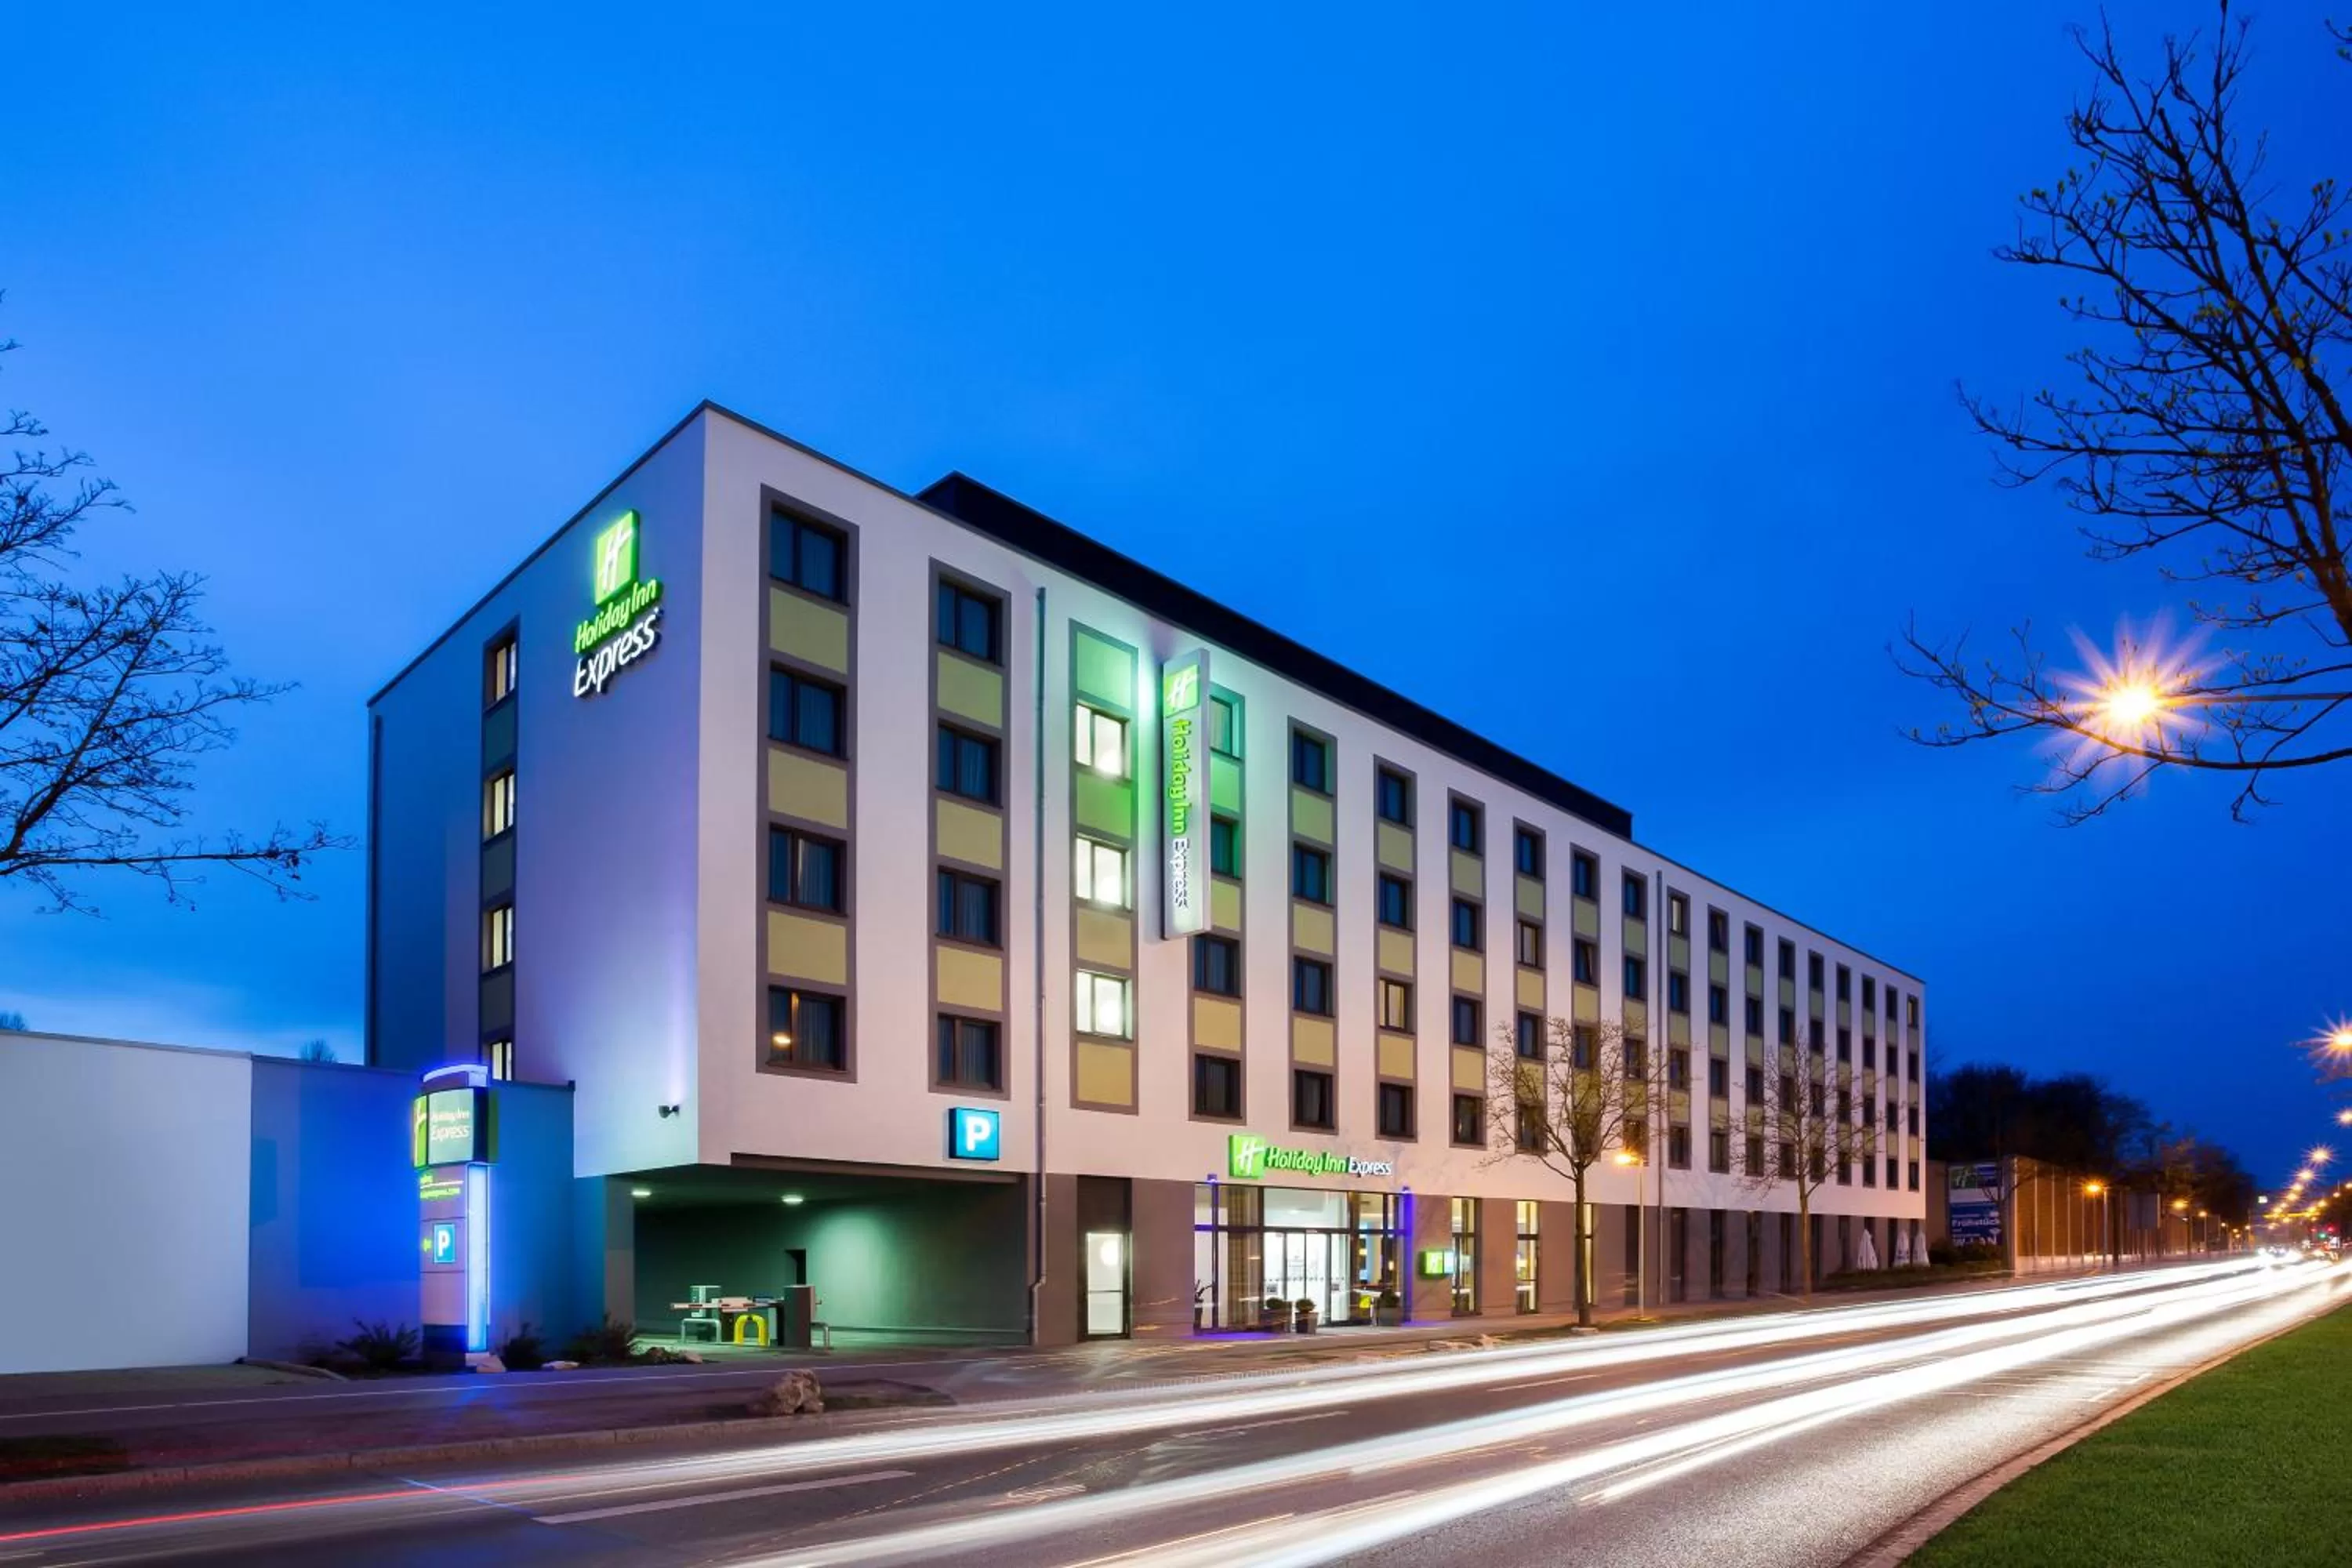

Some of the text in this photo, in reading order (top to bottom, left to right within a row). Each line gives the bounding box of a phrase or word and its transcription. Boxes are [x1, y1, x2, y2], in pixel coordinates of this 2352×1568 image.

[575, 579, 657, 654] Holiday Inn
[574, 614, 657, 698] Express
[1170, 719, 1191, 909] Holiday Inn Express
[966, 1116, 991, 1152] P
[1267, 1147, 1323, 1174] Holiday
[1324, 1152, 1346, 1173] Inn
[1348, 1157, 1392, 1176] Express
[438, 1230, 451, 1257] P
